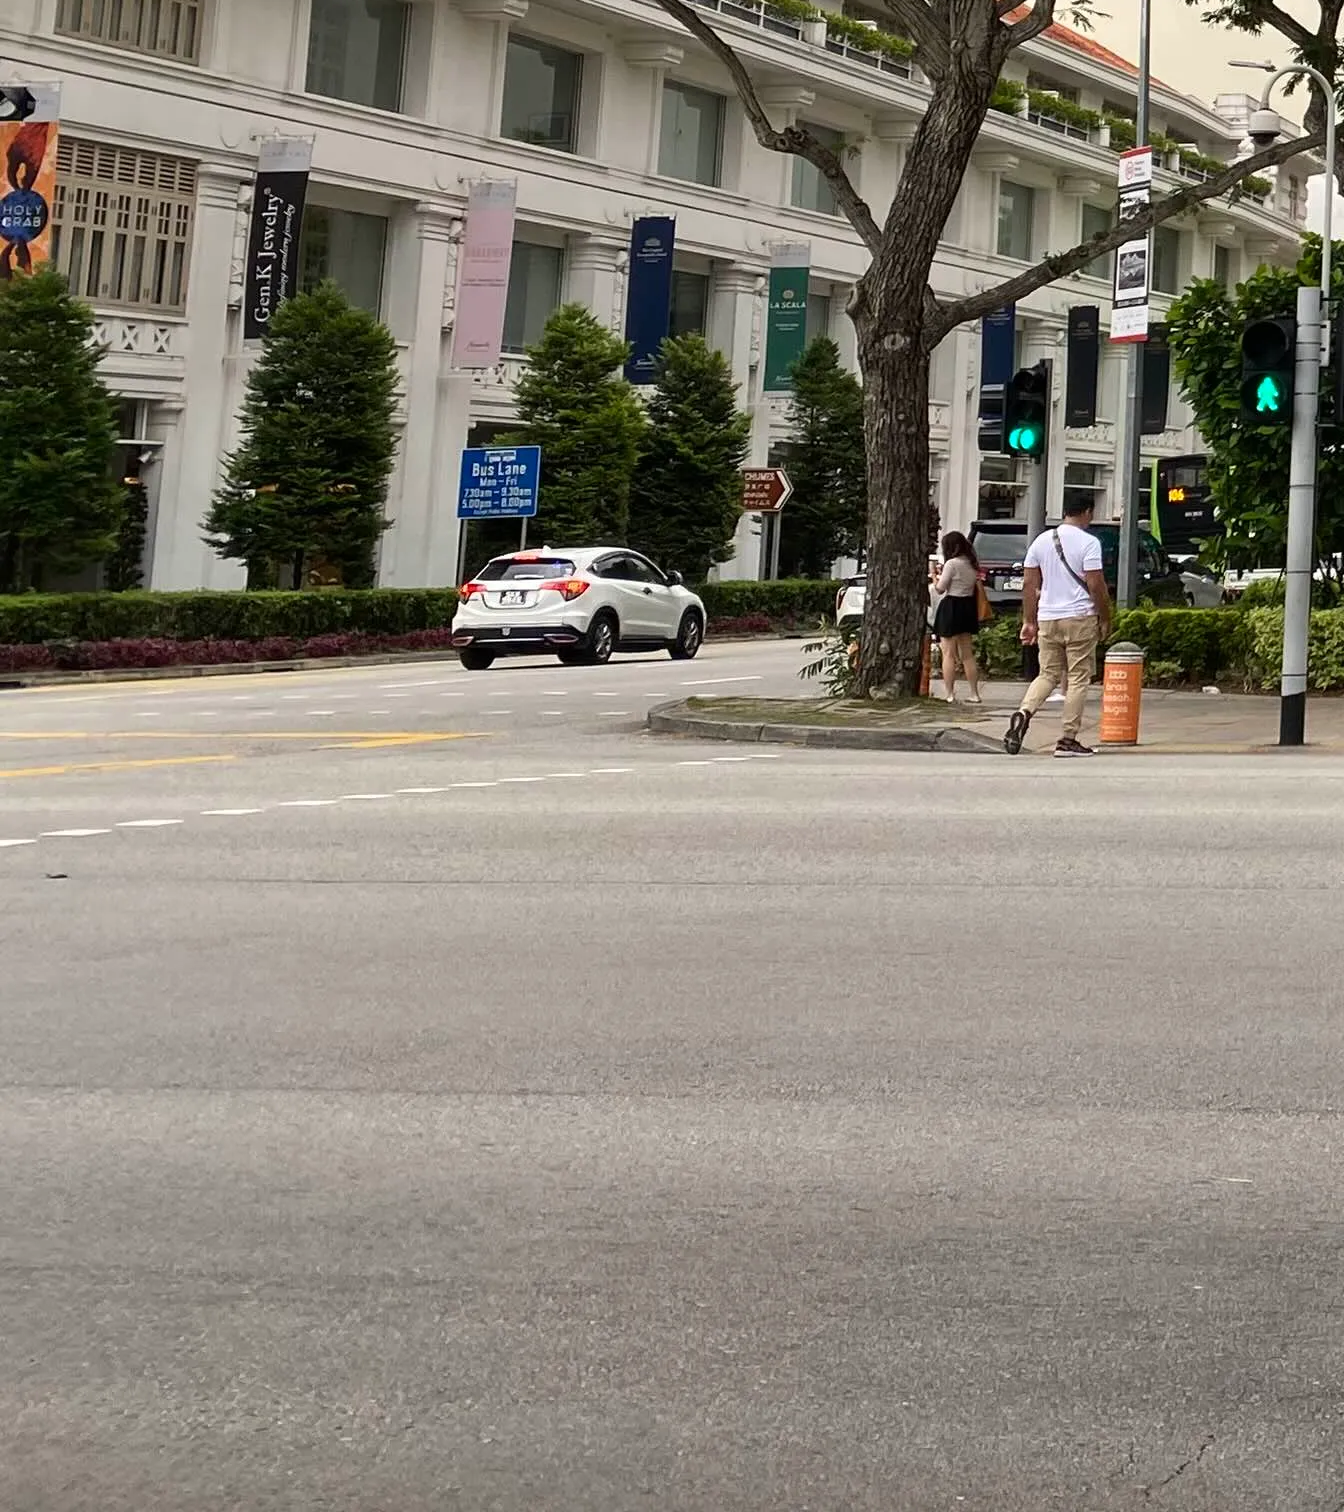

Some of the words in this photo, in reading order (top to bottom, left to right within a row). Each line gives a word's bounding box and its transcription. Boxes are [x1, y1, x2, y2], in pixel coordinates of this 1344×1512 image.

[2, 204, 42, 216] HOLY
[1, 216, 41, 227] CRAB
[472, 462, 495, 477] Bus
[498, 461, 527, 476] Lane
